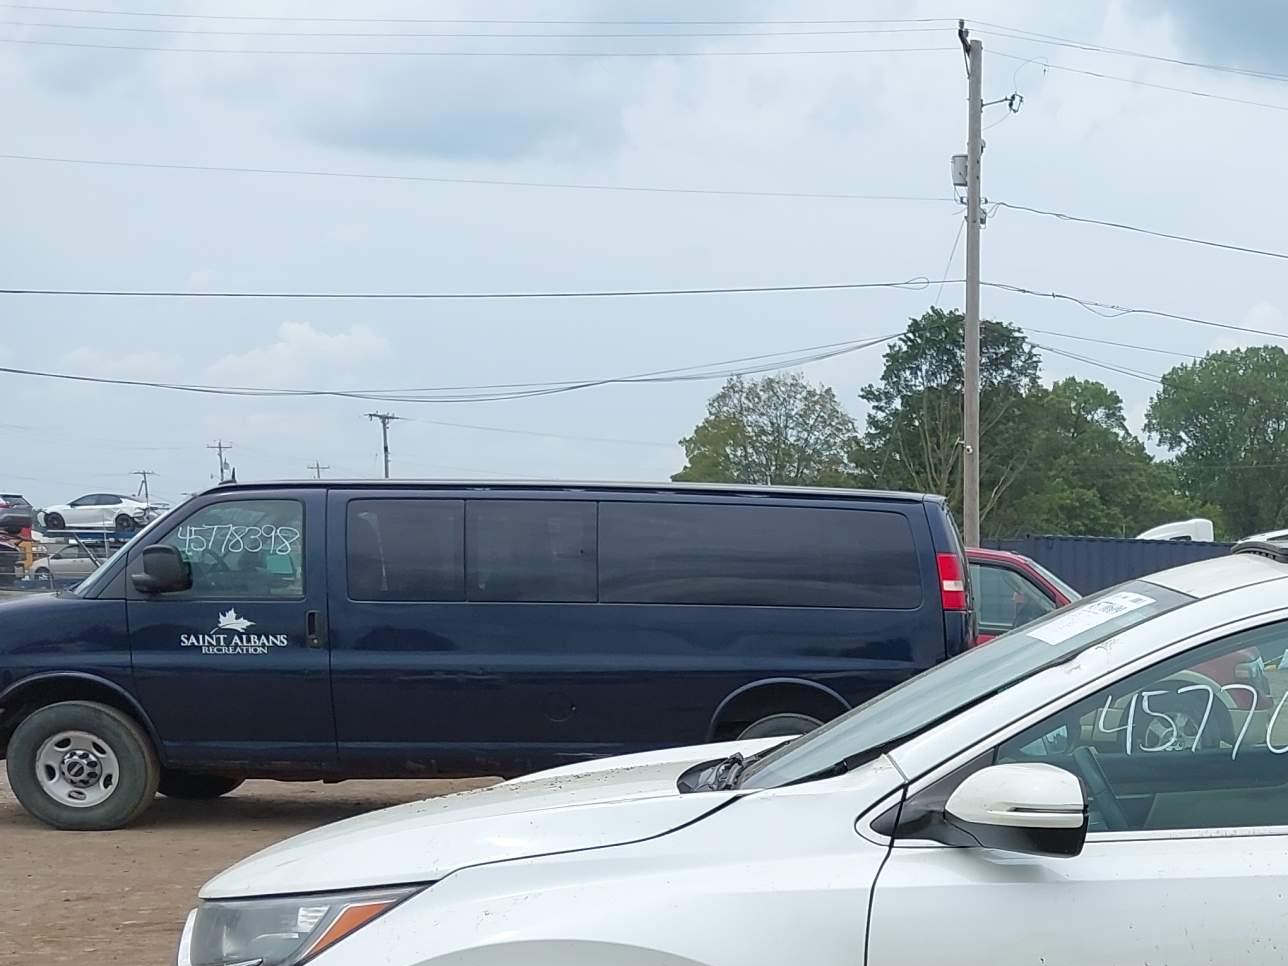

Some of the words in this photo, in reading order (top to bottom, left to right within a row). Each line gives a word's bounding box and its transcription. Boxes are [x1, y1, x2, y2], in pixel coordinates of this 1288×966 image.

[178, 524, 299, 555] 45778398
[180, 634, 227, 646] SAINT
[231, 634, 288, 646] ALBANS
[201, 646, 268, 654] RECREATION
